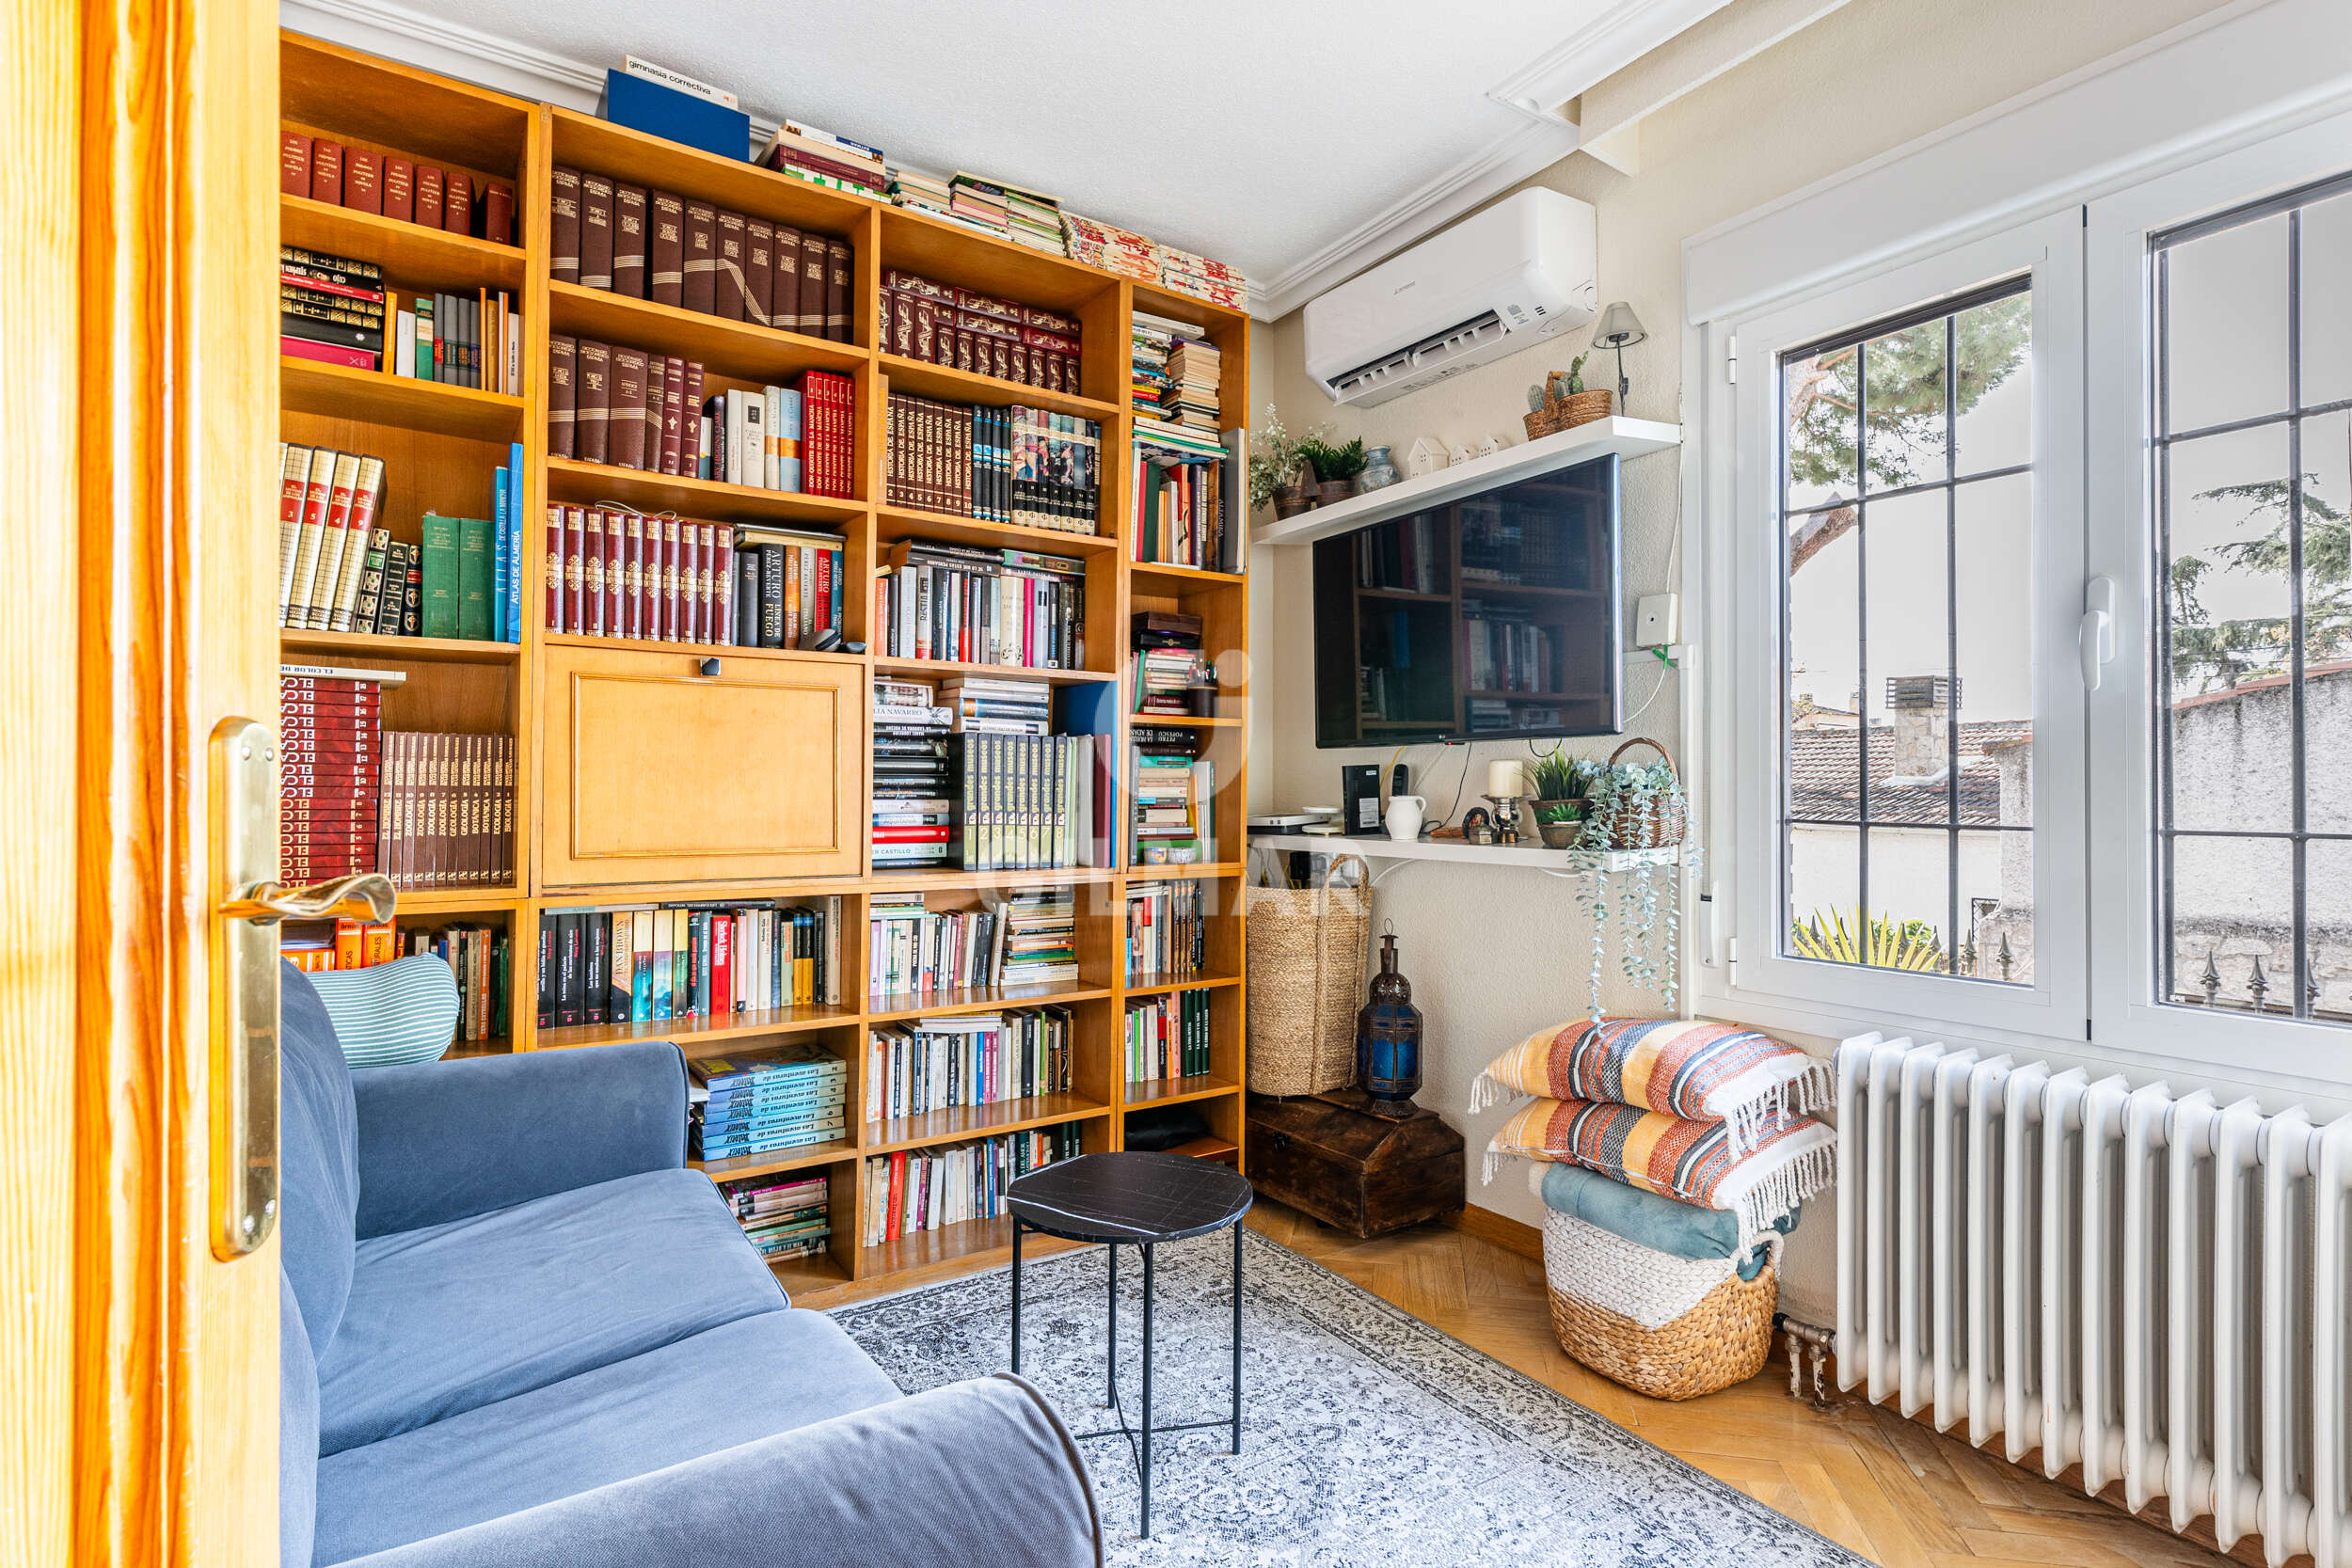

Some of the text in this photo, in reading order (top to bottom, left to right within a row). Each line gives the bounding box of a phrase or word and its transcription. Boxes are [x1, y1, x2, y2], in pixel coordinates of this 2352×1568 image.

[628, 59, 711, 95] gimnasia correctiva
[898, 438, 904, 449] DE
[907, 440, 914, 451] DE
[916, 442, 923, 451] DE
[926, 445, 932, 454] DE
[935, 446, 942, 455] DE
[945, 448, 951, 457] DE
[954, 450, 961, 459] DE
[964, 451, 971, 461] DE
[512, 531, 520, 565] ALMERÍA
[512, 566, 519, 577] DE
[771, 551, 781, 598] ARTURO
[774, 628, 781, 638] DE
[964, 775, 977, 811] grandes
[979, 776, 989, 812] grandes
[993, 776, 1002, 812] grandes
[1005, 777, 1015, 812] grandes
[1017, 777, 1027, 812] grandes
[1030, 778, 1040, 813] grandes
[1042, 778, 1052, 813] grandes
[1056, 778, 1065, 813] grandes
[968, 829, 972, 840] 1
[981, 829, 988, 840] 2
[994, 829, 1001, 840] 3
[1007, 829, 1014, 840] 4
[1020, 829, 1026, 840] 5
[1030, 829, 1037, 840] 6
[1041, 829, 1048, 840] 7
[1057, 829, 1062, 839] 8
[615, 920, 624, 974] DAN BROWN
[772, 1070, 805, 1080] aventuras
[772, 1082, 804, 1092] aventuras
[771, 1092, 803, 1101] aventuras
[771, 1101, 803, 1111] aventuras
[768, 1115, 801, 1124] aventuras
[768, 1125, 801, 1135] aventuras
[770, 1138, 803, 1148] aventuras
